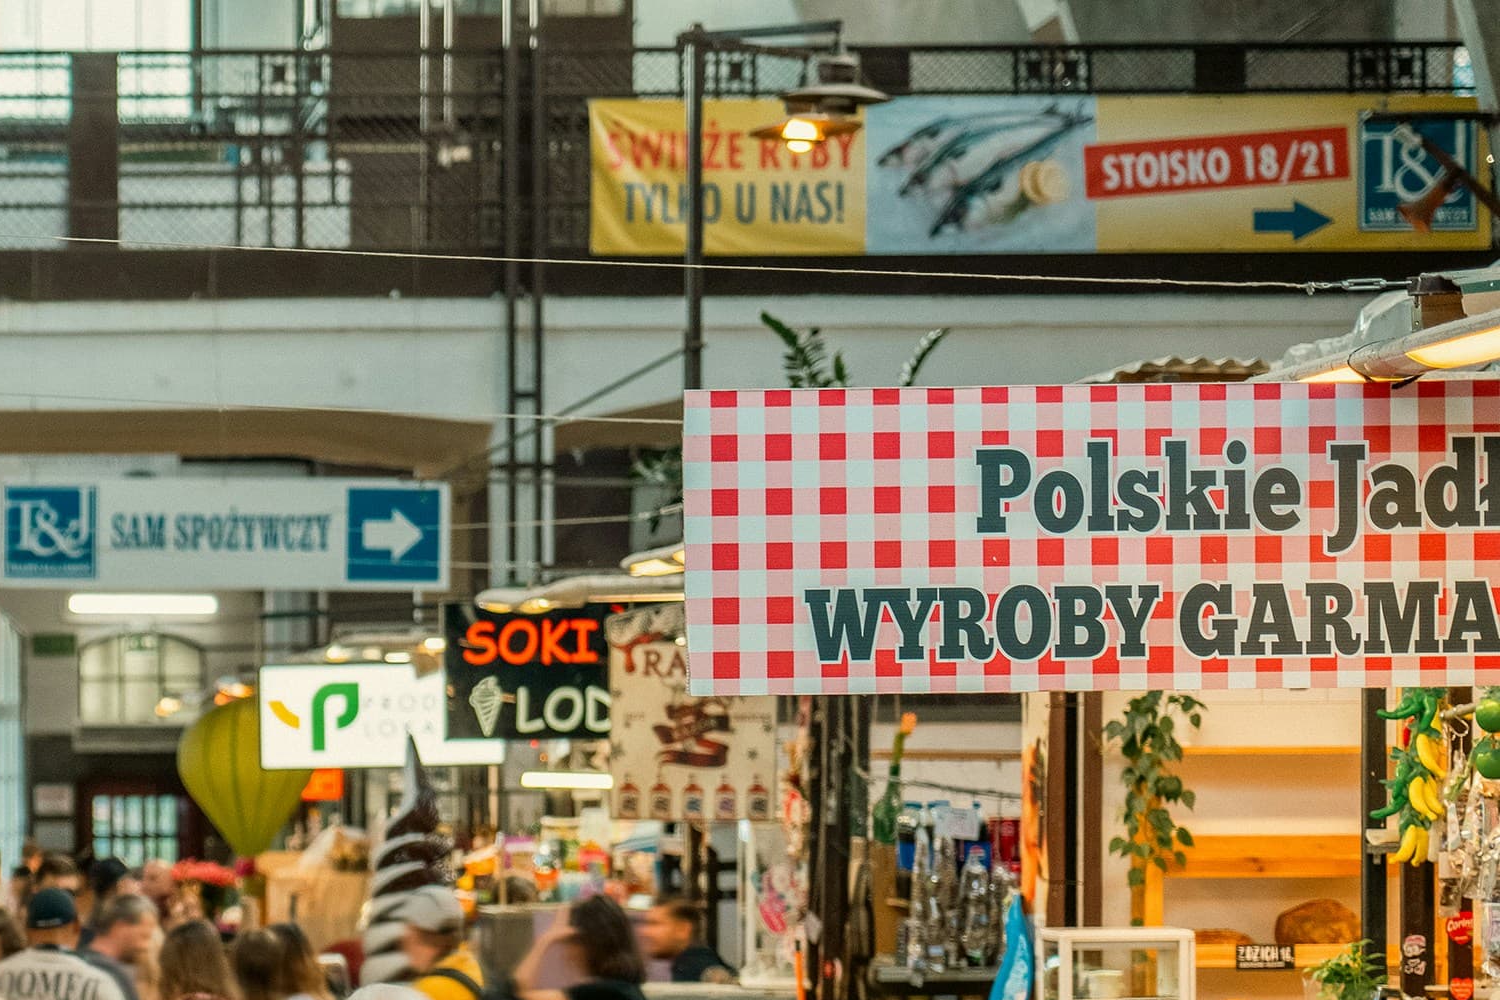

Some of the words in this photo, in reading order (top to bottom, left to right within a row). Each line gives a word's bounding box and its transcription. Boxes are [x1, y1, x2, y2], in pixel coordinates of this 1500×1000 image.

[1103, 145, 1231, 191] STOISKO
[1243, 138, 1336, 185] 18/21
[735, 182, 756, 224] U
[770, 180, 845, 224] NAS!
[975, 439, 1301, 533] Polskie
[111, 513, 167, 550] SAM
[174, 506, 332, 552] SPOŻYWCZY
[463, 619, 598, 665] SOKI
[805, 584, 1160, 661] WYROBY
[1179, 581, 1500, 656] GARMA
